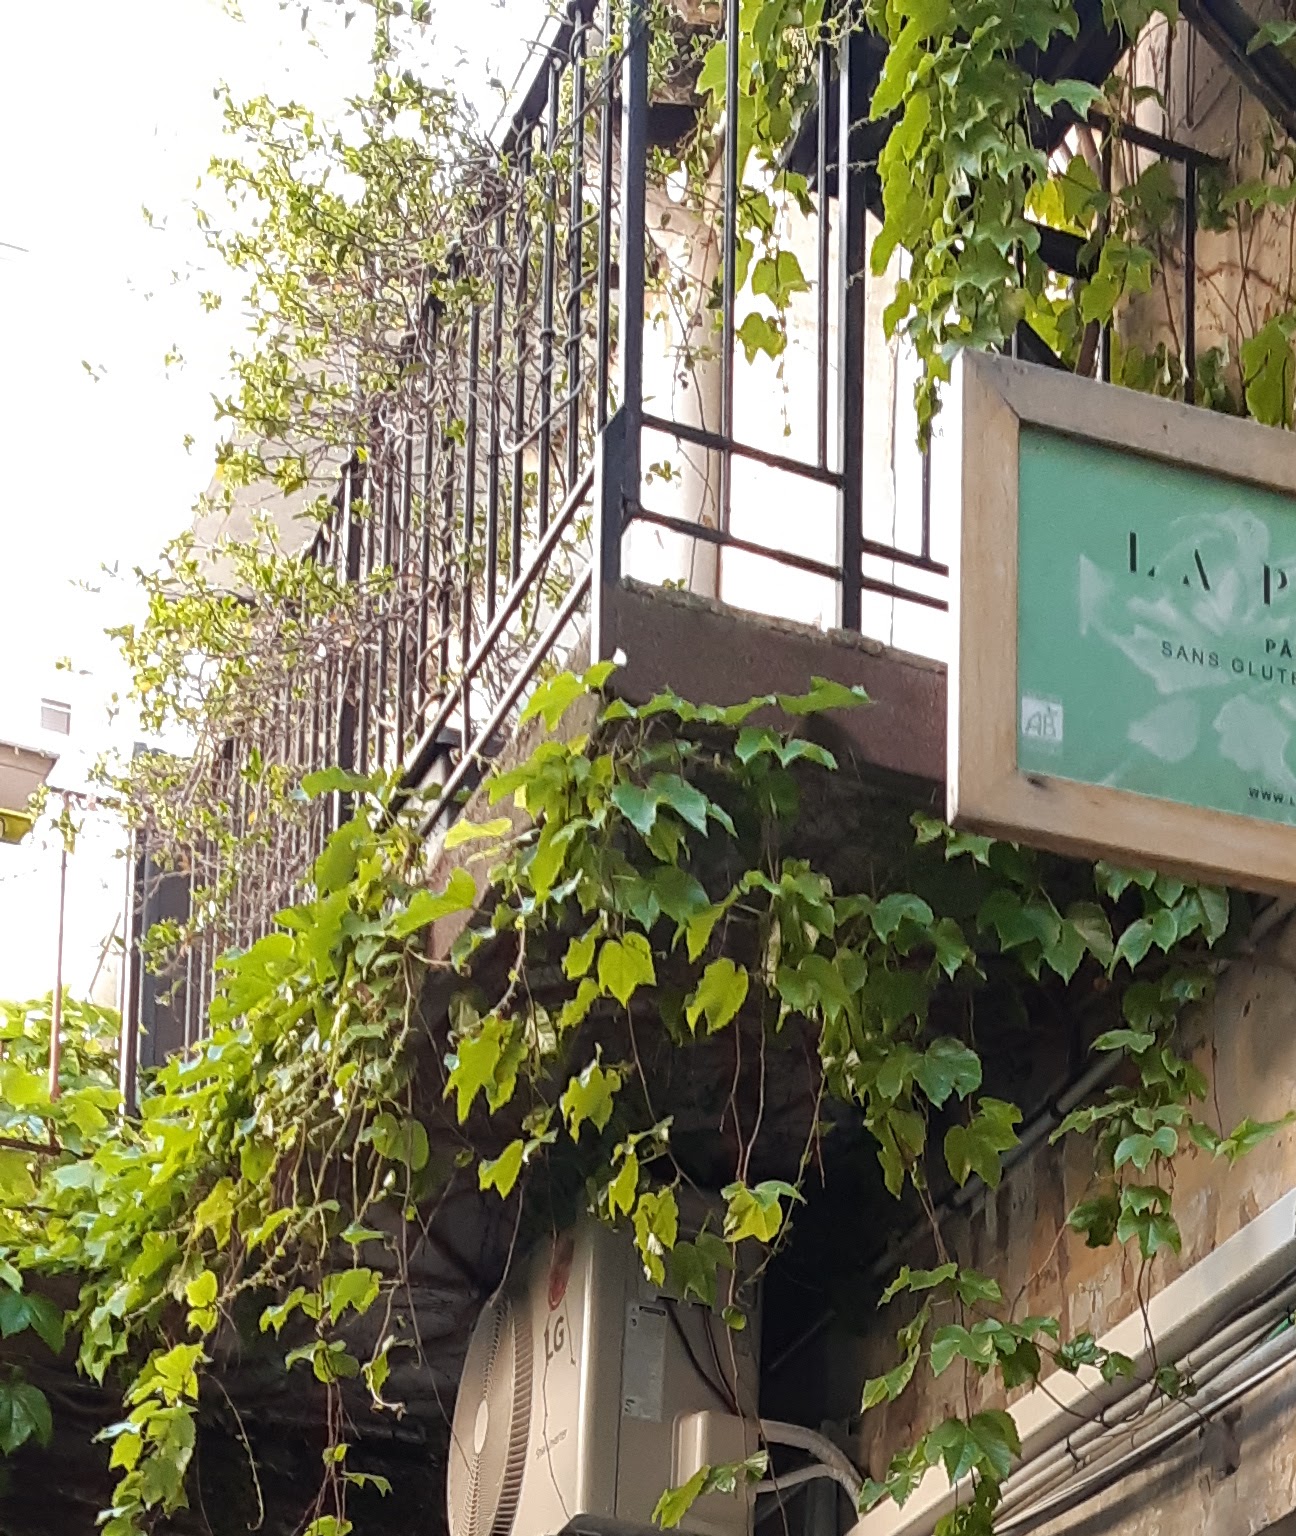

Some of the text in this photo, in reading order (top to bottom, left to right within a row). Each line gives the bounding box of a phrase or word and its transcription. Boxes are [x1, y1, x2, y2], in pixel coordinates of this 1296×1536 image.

[1128, 530, 1211, 592] LA
[1160, 640, 1220, 669] SANS
[544, 1315, 564, 1361] LG
